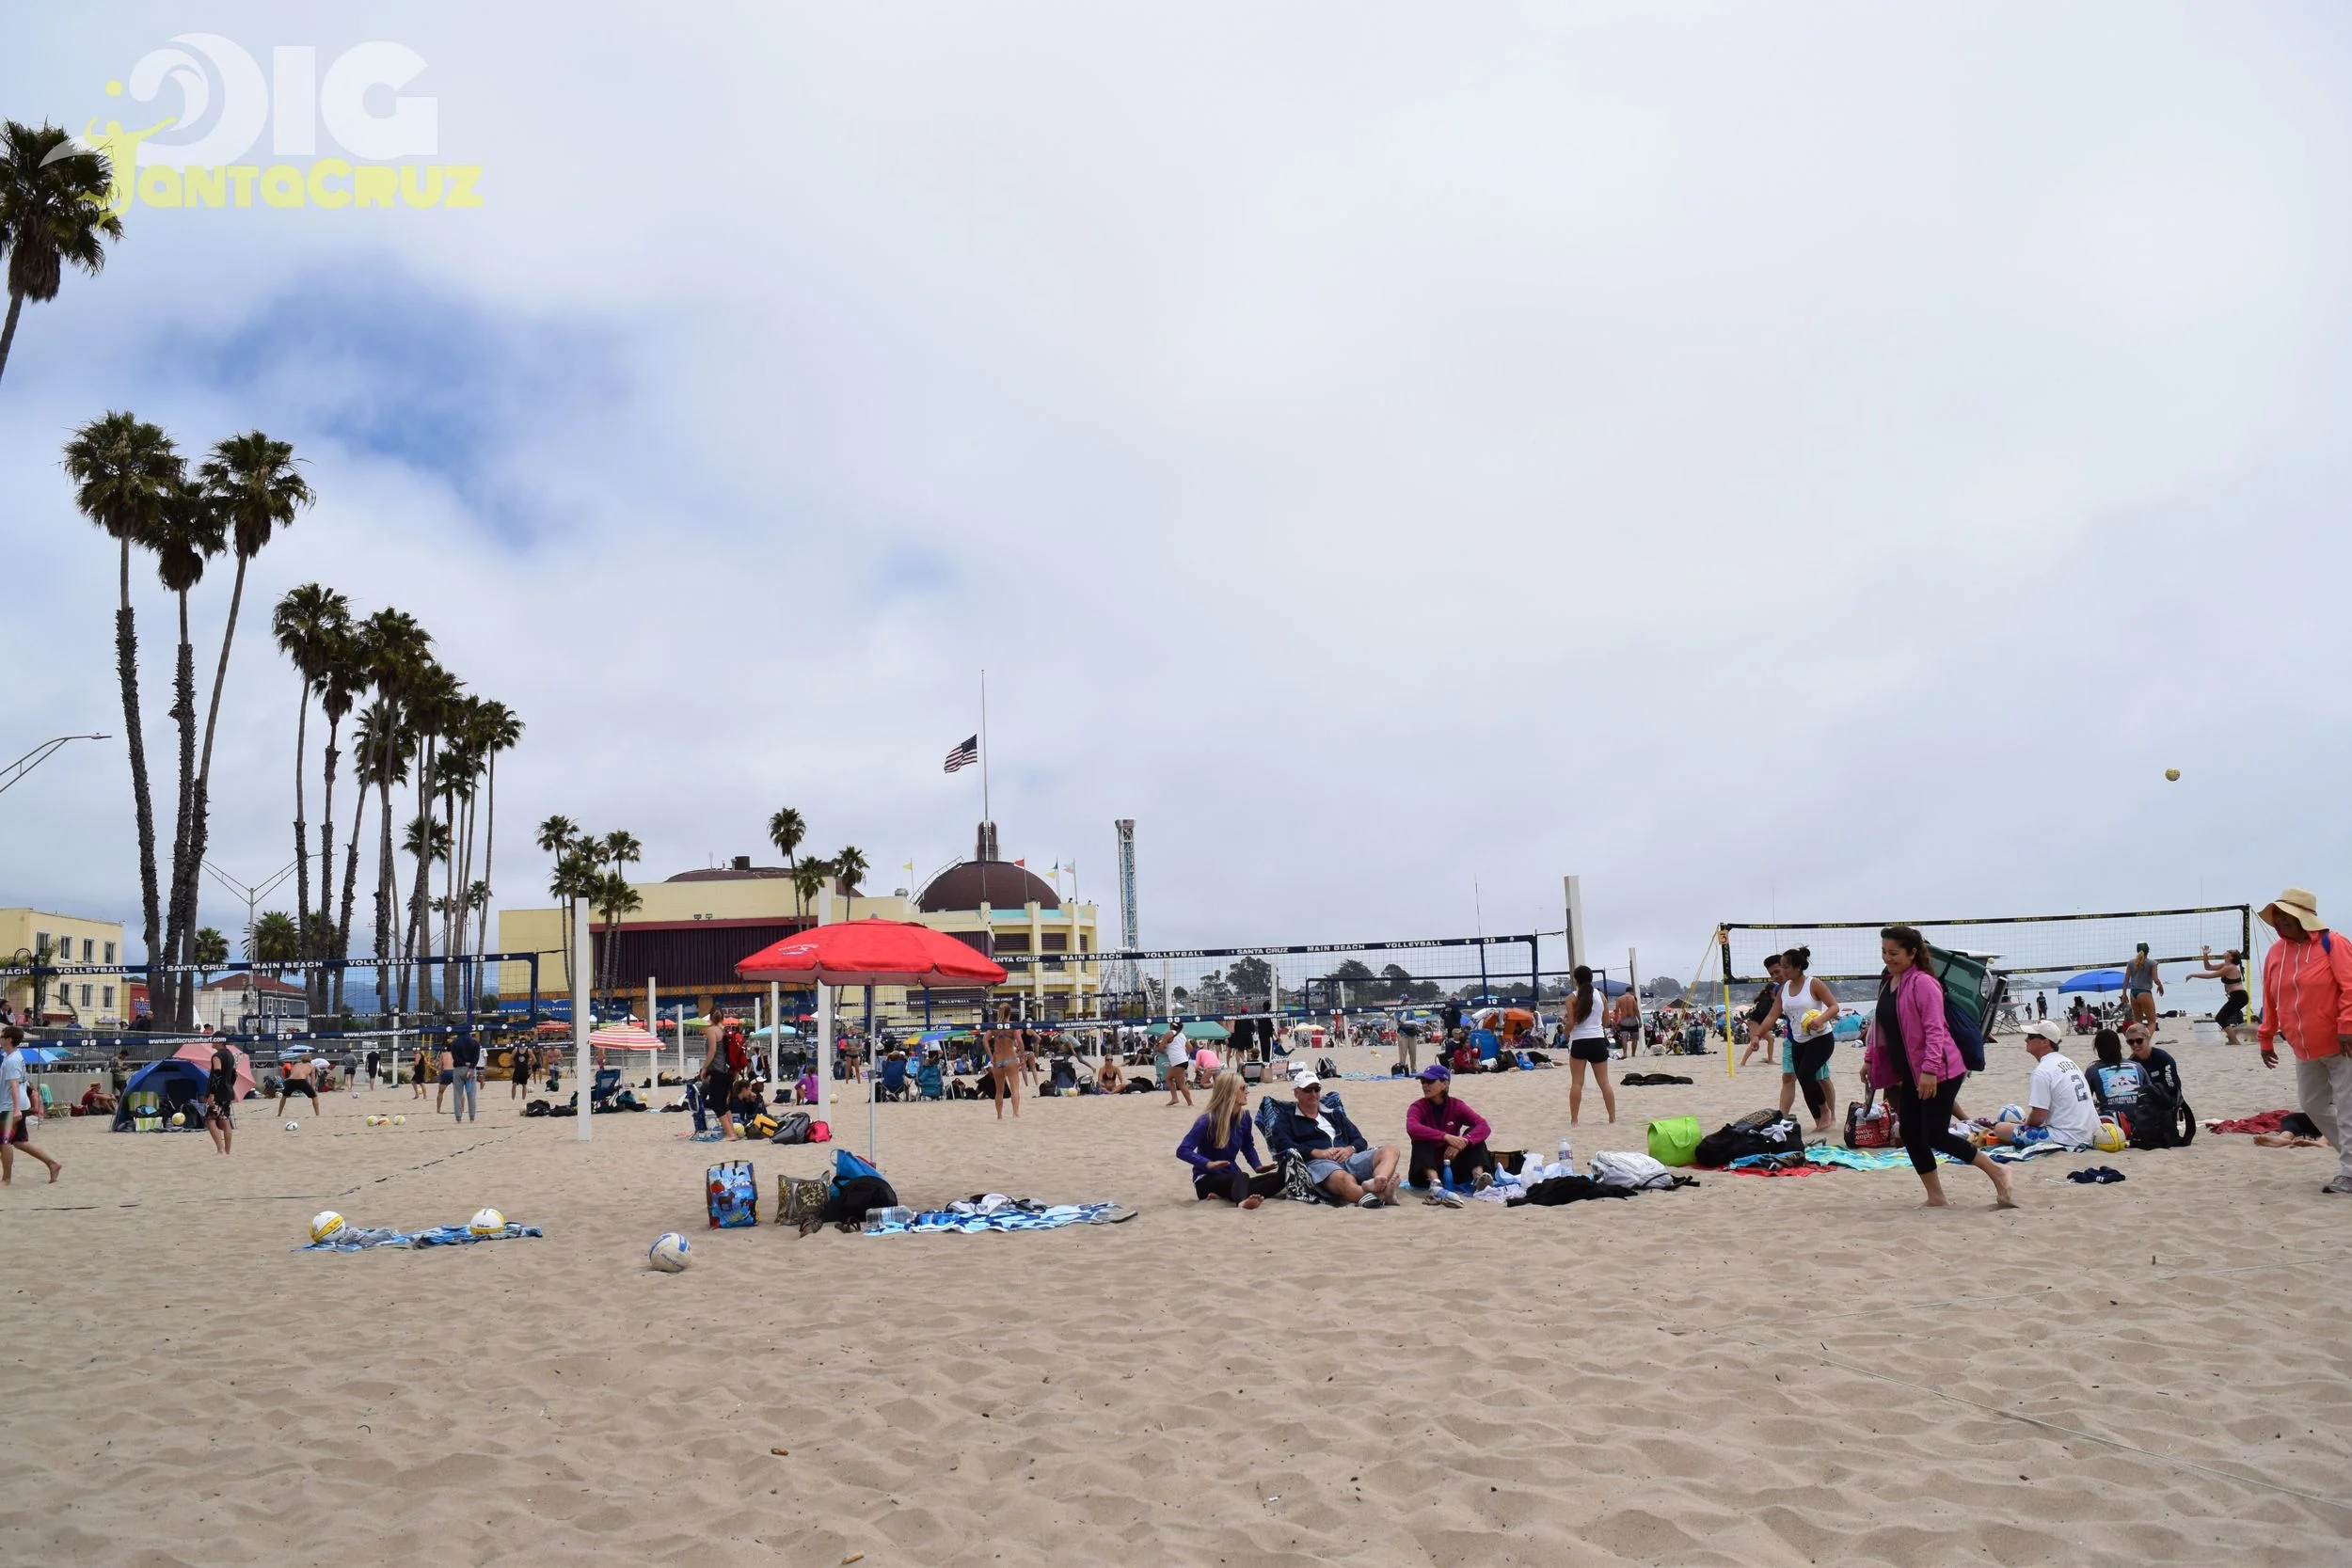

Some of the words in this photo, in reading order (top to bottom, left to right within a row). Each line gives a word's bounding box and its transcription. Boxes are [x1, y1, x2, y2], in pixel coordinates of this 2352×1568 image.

[1385, 940, 1443, 949] VOLLEYBALL
[0, 968, 30, 976] EACH
[56, 966, 129, 974] VOLLEYBALL
[167, 964, 199, 973] SANTA
[251, 961, 280, 970] MAIN
[284, 960, 324, 969] BEACH
[348, 958, 420, 967] VOLLEYBALL
[882, 1024, 951, 1033] www.santacruzwarf.com
[1055, 1019, 1123, 1029] www.santacruzwharf.com
[1223, 1011, 1289, 1021] www.santacruzwharf.com
[149, 1036, 227, 1045] www.santacruzwharf.com
[343, 1027, 420, 1037] www.santacruzwharf.com
[2071, 1074, 2089, 1101] 2
